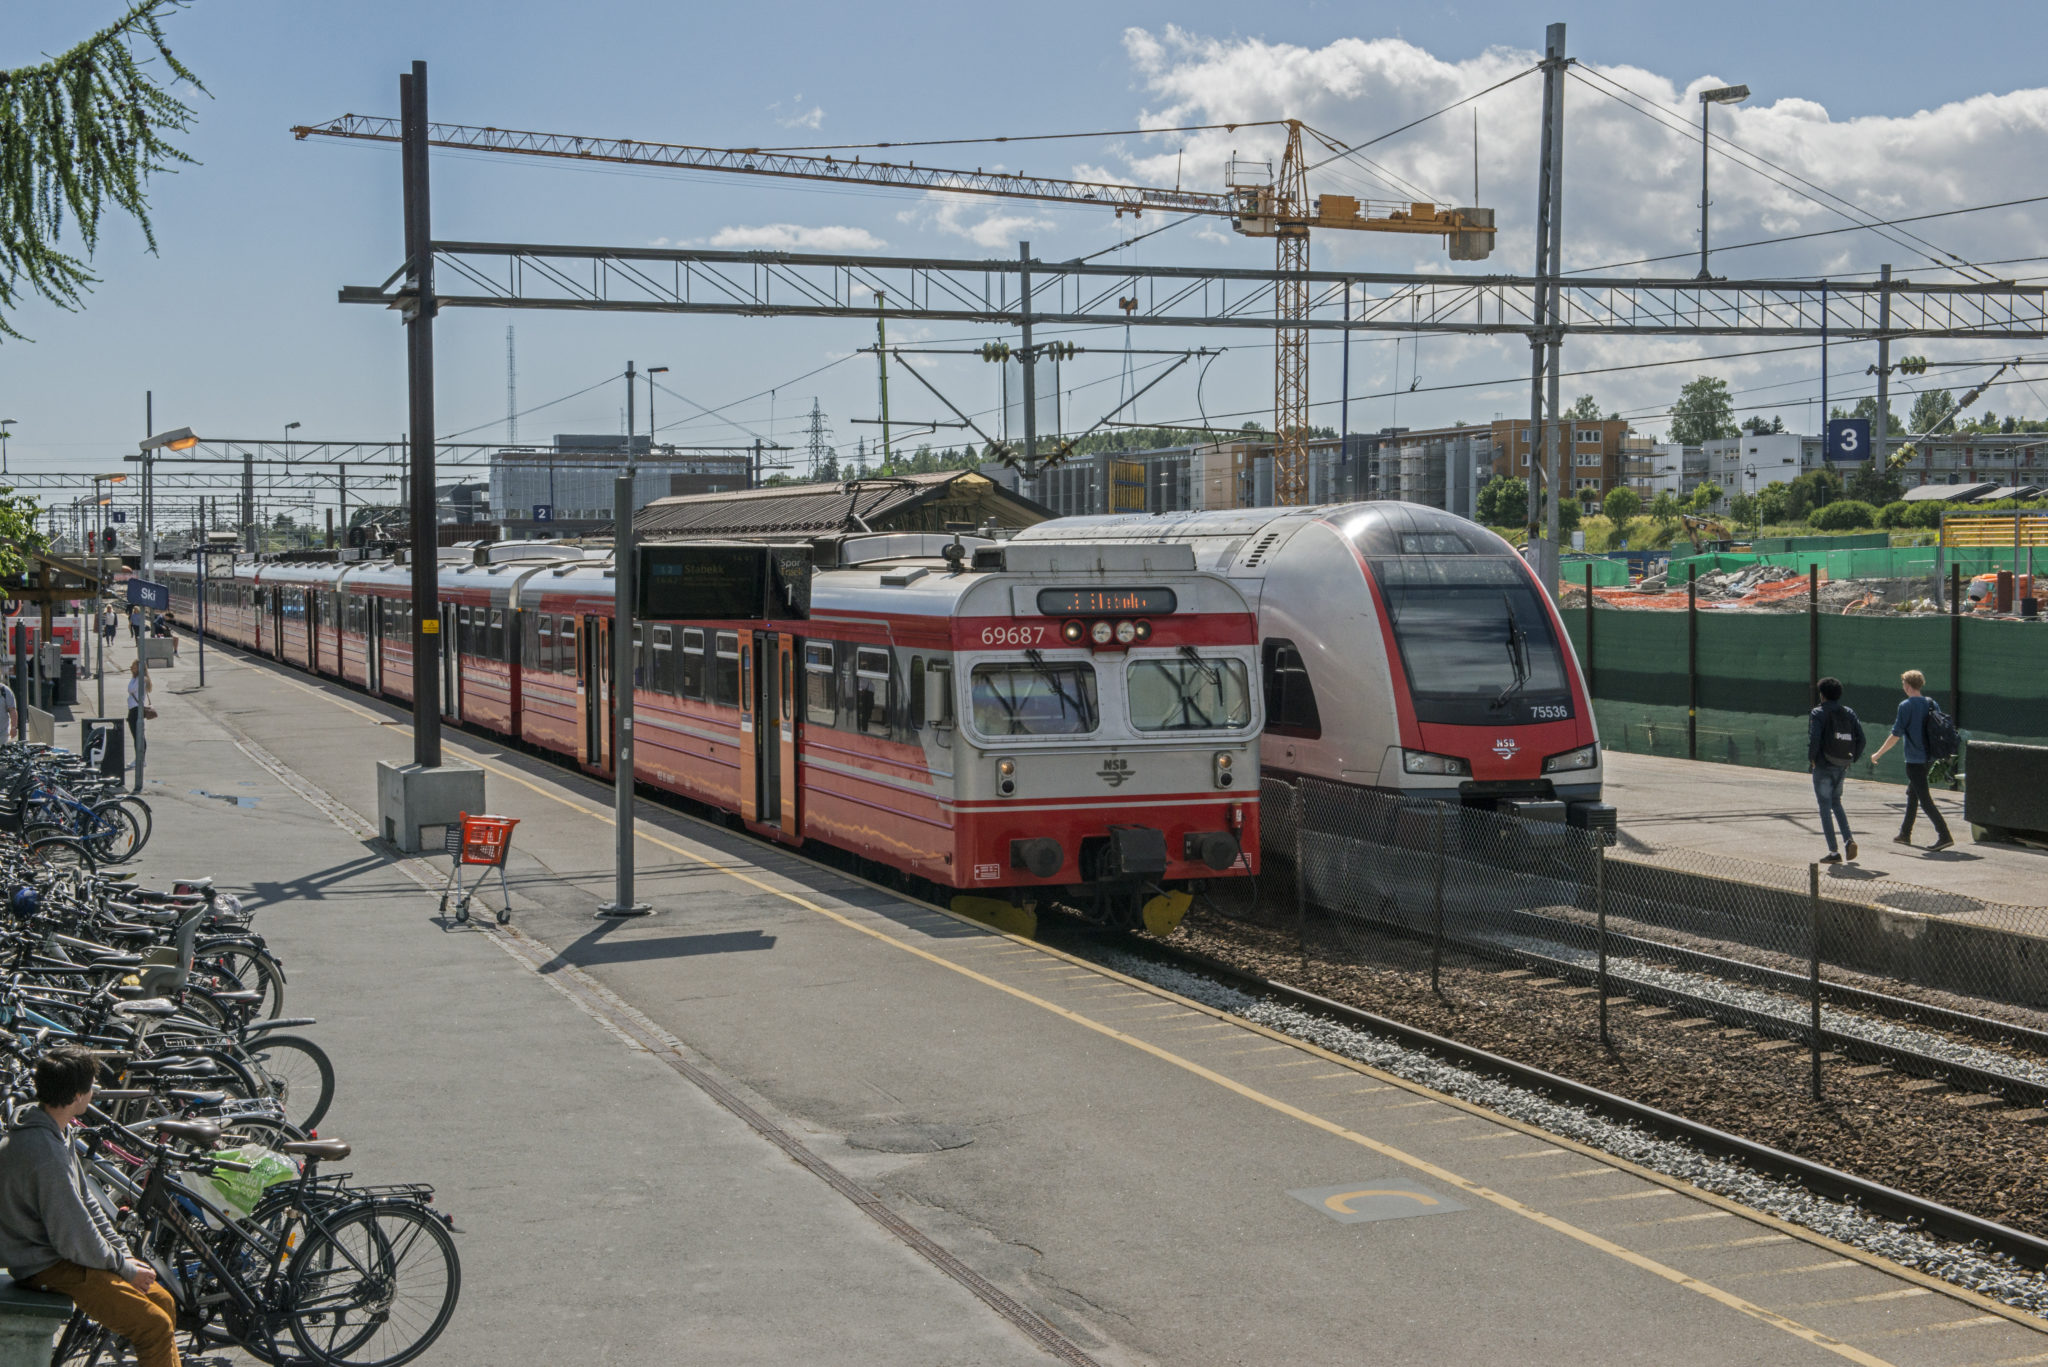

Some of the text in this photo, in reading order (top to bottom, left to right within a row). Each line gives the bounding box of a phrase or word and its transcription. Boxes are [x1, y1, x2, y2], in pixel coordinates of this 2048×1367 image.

[1840, 428, 1858, 451] 3
[538, 508, 546, 519] 2
[779, 559, 801, 568] Spor
[140, 587, 156, 601] Ski
[785, 583, 793, 606] 1
[981, 626, 1045, 645] 69687
[1530, 705, 1568, 718] 75536
[1496, 738, 1515, 747] NSB
[1103, 759, 1128, 770] NSB
